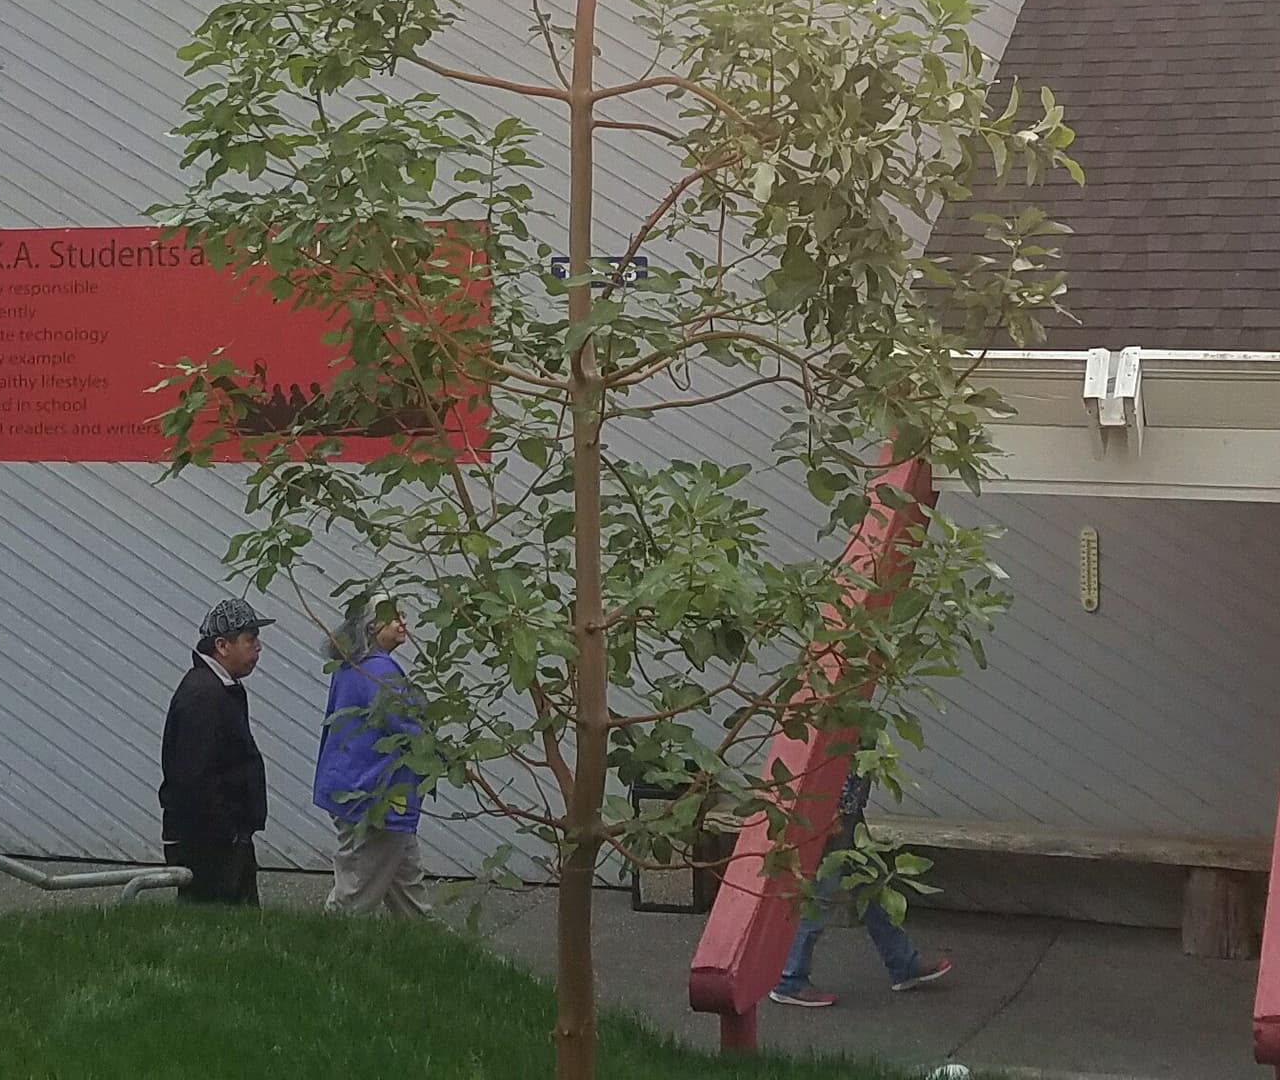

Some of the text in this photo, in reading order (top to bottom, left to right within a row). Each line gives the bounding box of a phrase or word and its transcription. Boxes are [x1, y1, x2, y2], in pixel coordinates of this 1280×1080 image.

[49, 238, 180, 269] Students
[9, 280, 98, 297] responsible
[19, 326, 109, 343] technology
[9, 351, 76, 367] example
[41, 373, 108, 391] lifestyles
[17, 398, 31, 411] in
[35, 397, 87, 412] school
[9, 421, 66, 435] readers
[72, 422, 101, 435] and
[107, 422, 161, 435] writers
